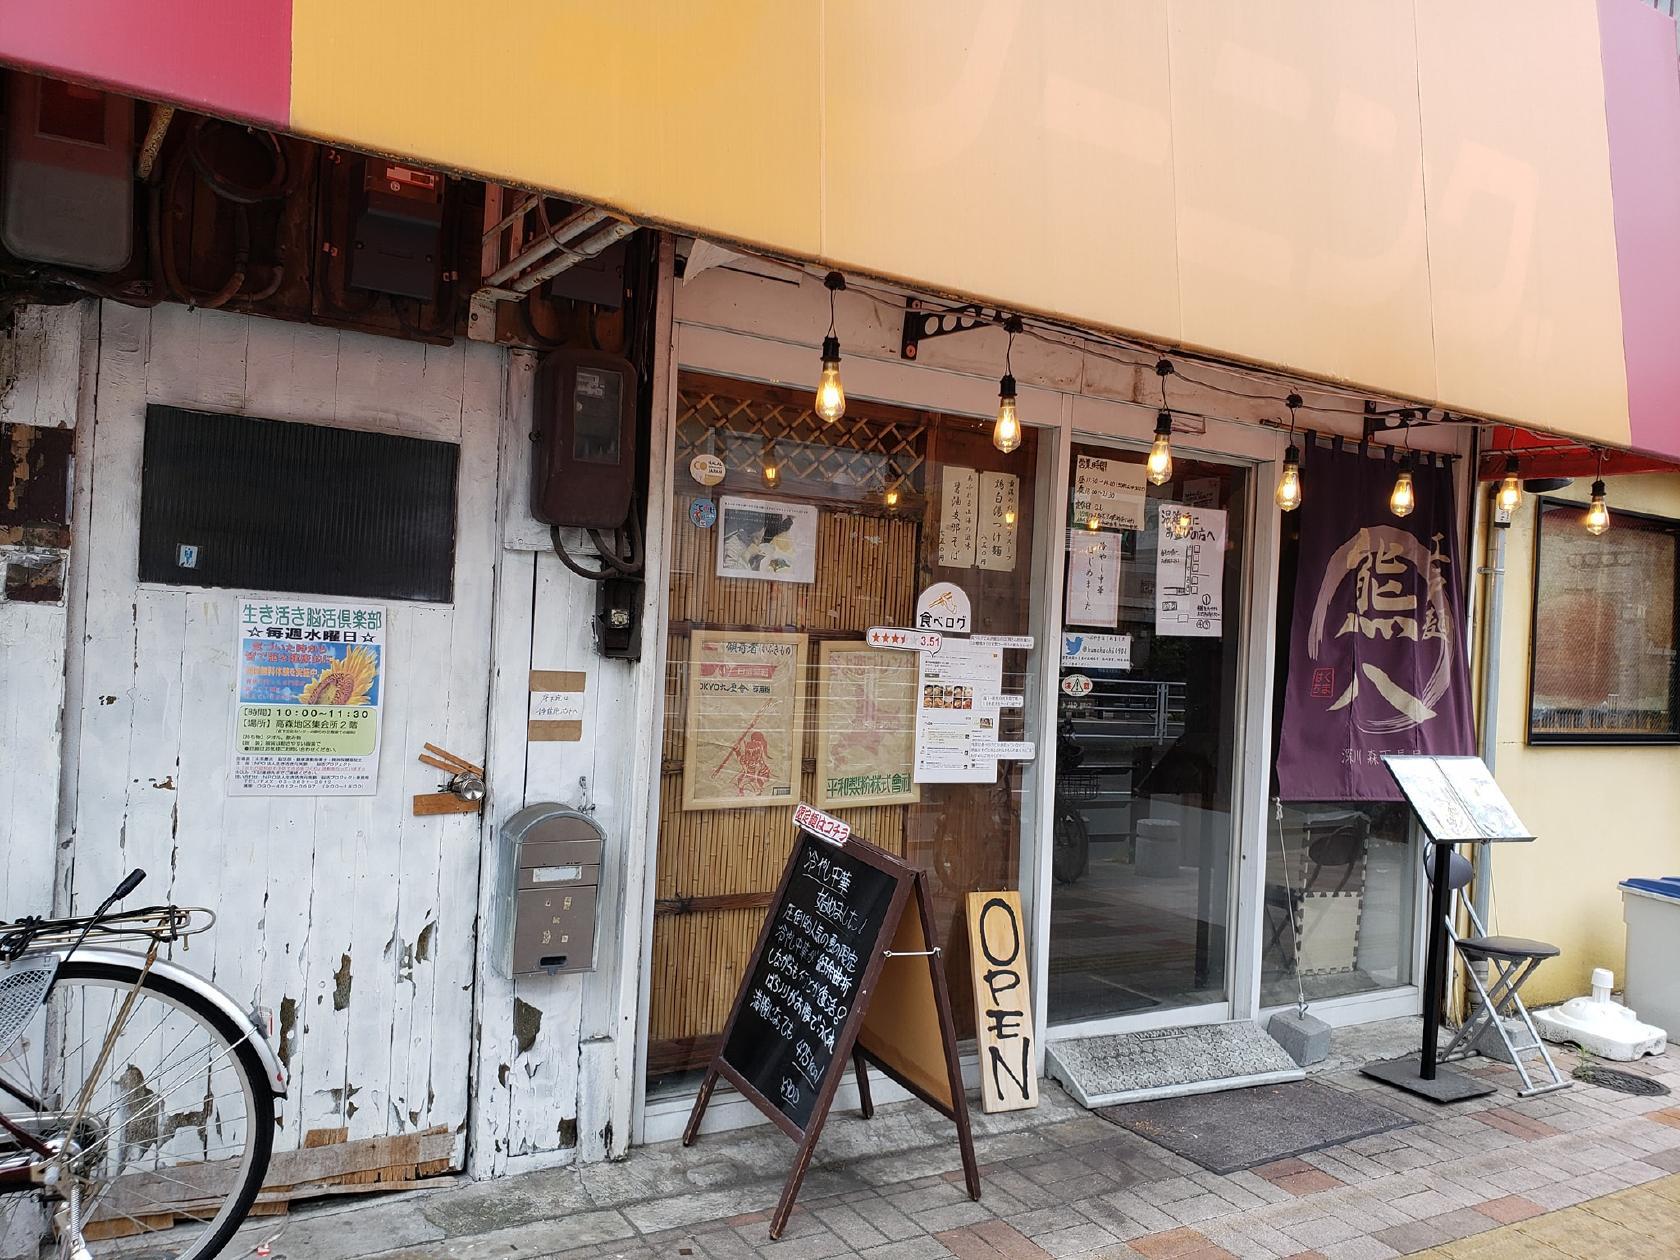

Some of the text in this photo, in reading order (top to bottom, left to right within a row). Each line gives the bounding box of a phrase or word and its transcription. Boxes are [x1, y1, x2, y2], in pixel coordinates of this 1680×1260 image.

[1078, 457, 1108, 473] 営業時間
[242, 604, 382, 630] 生き活き脳活倶楽部
[919, 611, 967, 630] 食べログ
[920, 636, 940, 648] 3.51
[795, 805, 849, 842] 限定麺はコチラ
[803, 847, 853, 895] 冷やし中華
[979, 898, 1030, 1102] OPEN
